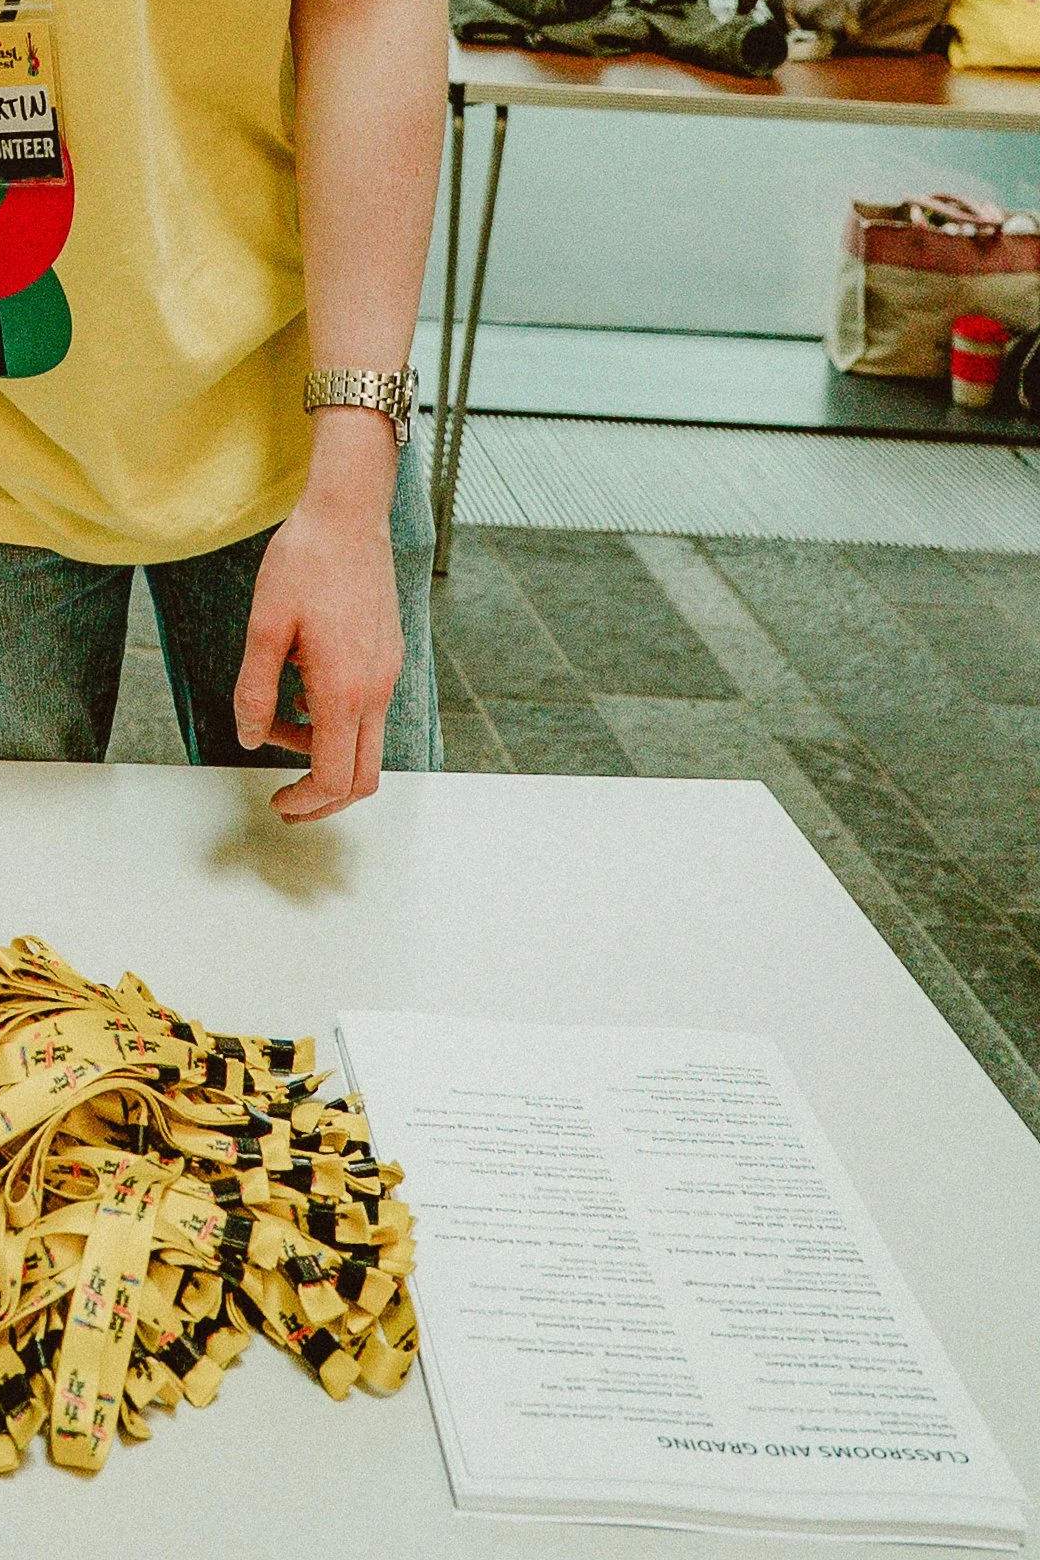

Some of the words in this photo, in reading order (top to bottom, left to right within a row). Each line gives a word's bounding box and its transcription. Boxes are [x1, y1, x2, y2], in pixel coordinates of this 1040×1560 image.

[657, 1435, 758, 1455] GRADING
[766, 1443, 810, 1457] AND
[818, 1445, 970, 1464] CLASSROOMS
